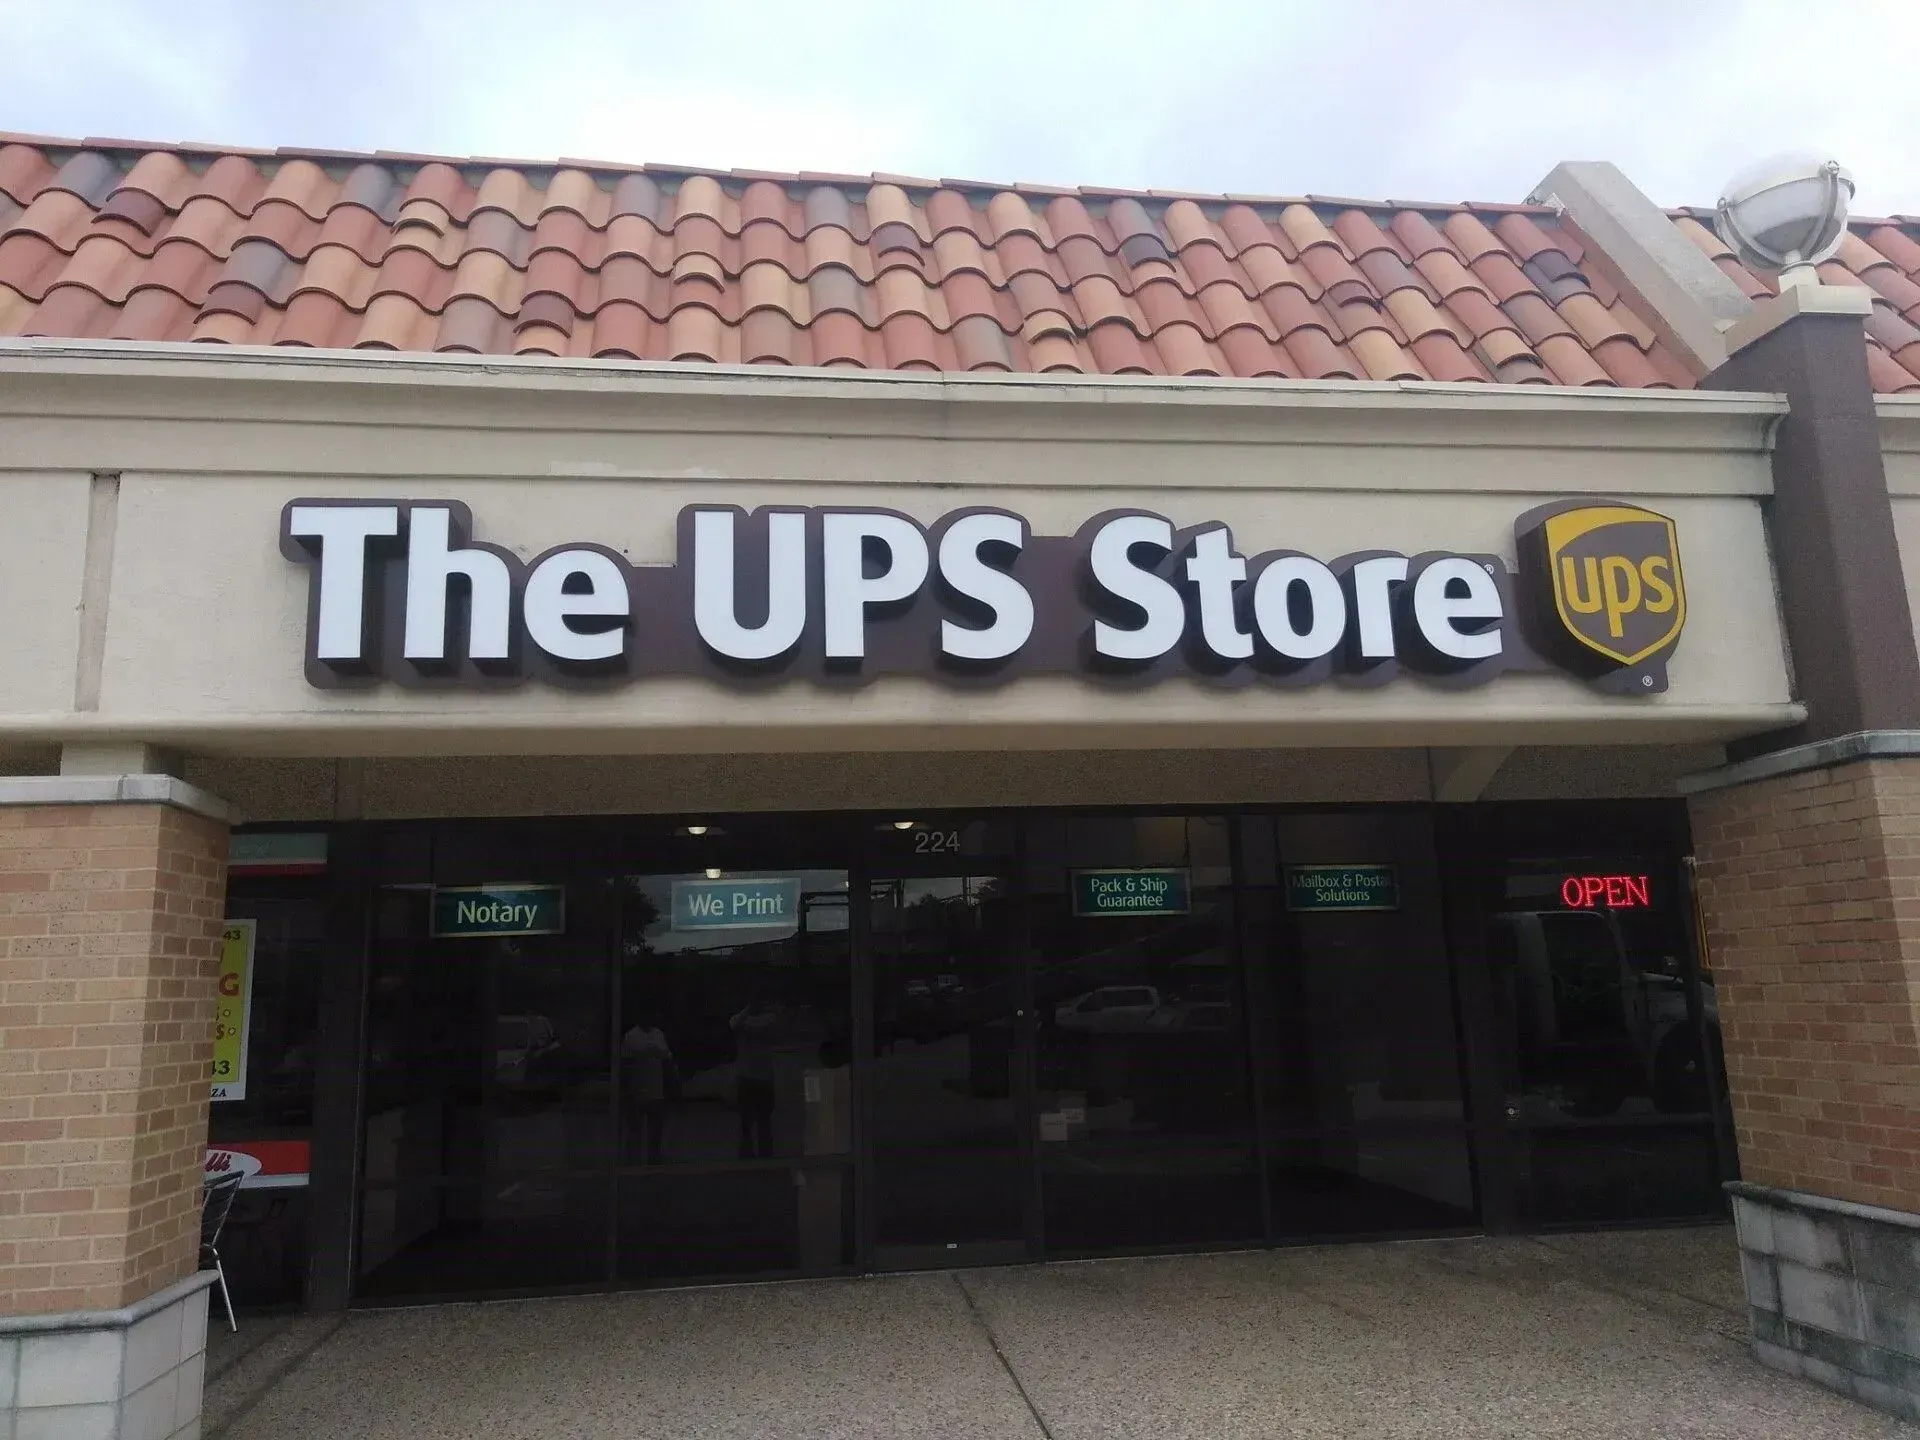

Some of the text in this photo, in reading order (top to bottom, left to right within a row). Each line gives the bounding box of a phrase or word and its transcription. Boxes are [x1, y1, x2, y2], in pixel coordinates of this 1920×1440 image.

[290, 506, 1504, 660] The UPS Store
[1561, 555, 1675, 638] ups
[915, 831, 960, 853] 224
[1091, 877, 1168, 895] Pack & Ship
[1292, 874, 1340, 889] Mailbox
[1342, 873, 1353, 888] &
[1562, 875, 1649, 907] OPEN
[688, 892, 784, 917] We Print
[1097, 893, 1163, 907] Guarantee
[1315, 889, 1371, 902] Solutions
[457, 900, 538, 928] Notary
